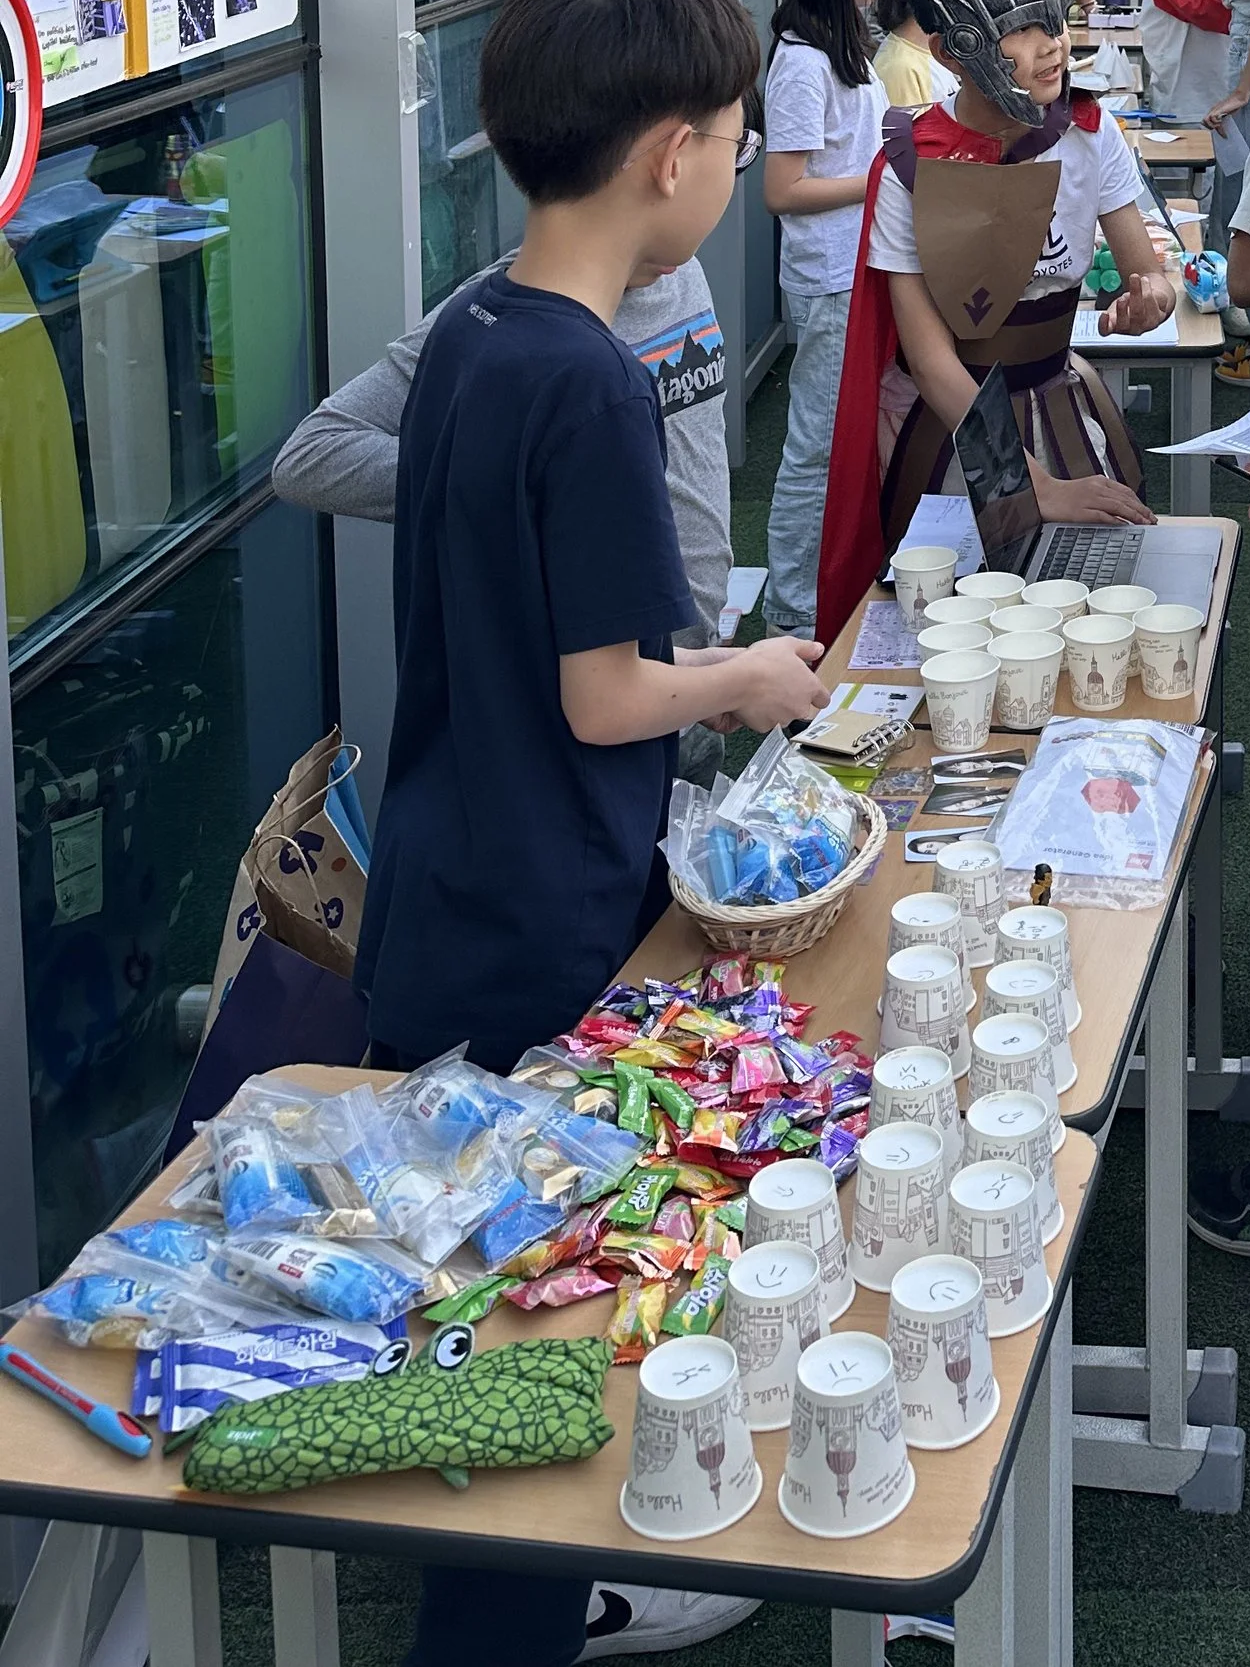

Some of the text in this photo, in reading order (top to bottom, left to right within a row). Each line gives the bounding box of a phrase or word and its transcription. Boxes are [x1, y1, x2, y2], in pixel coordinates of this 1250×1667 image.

[656, 352, 726, 408] tagoni
[1043, 847, 1092, 859] Generator
[233, 1329, 338, 1366] 화이트하임
[647, 1494, 684, 1512] Hello
